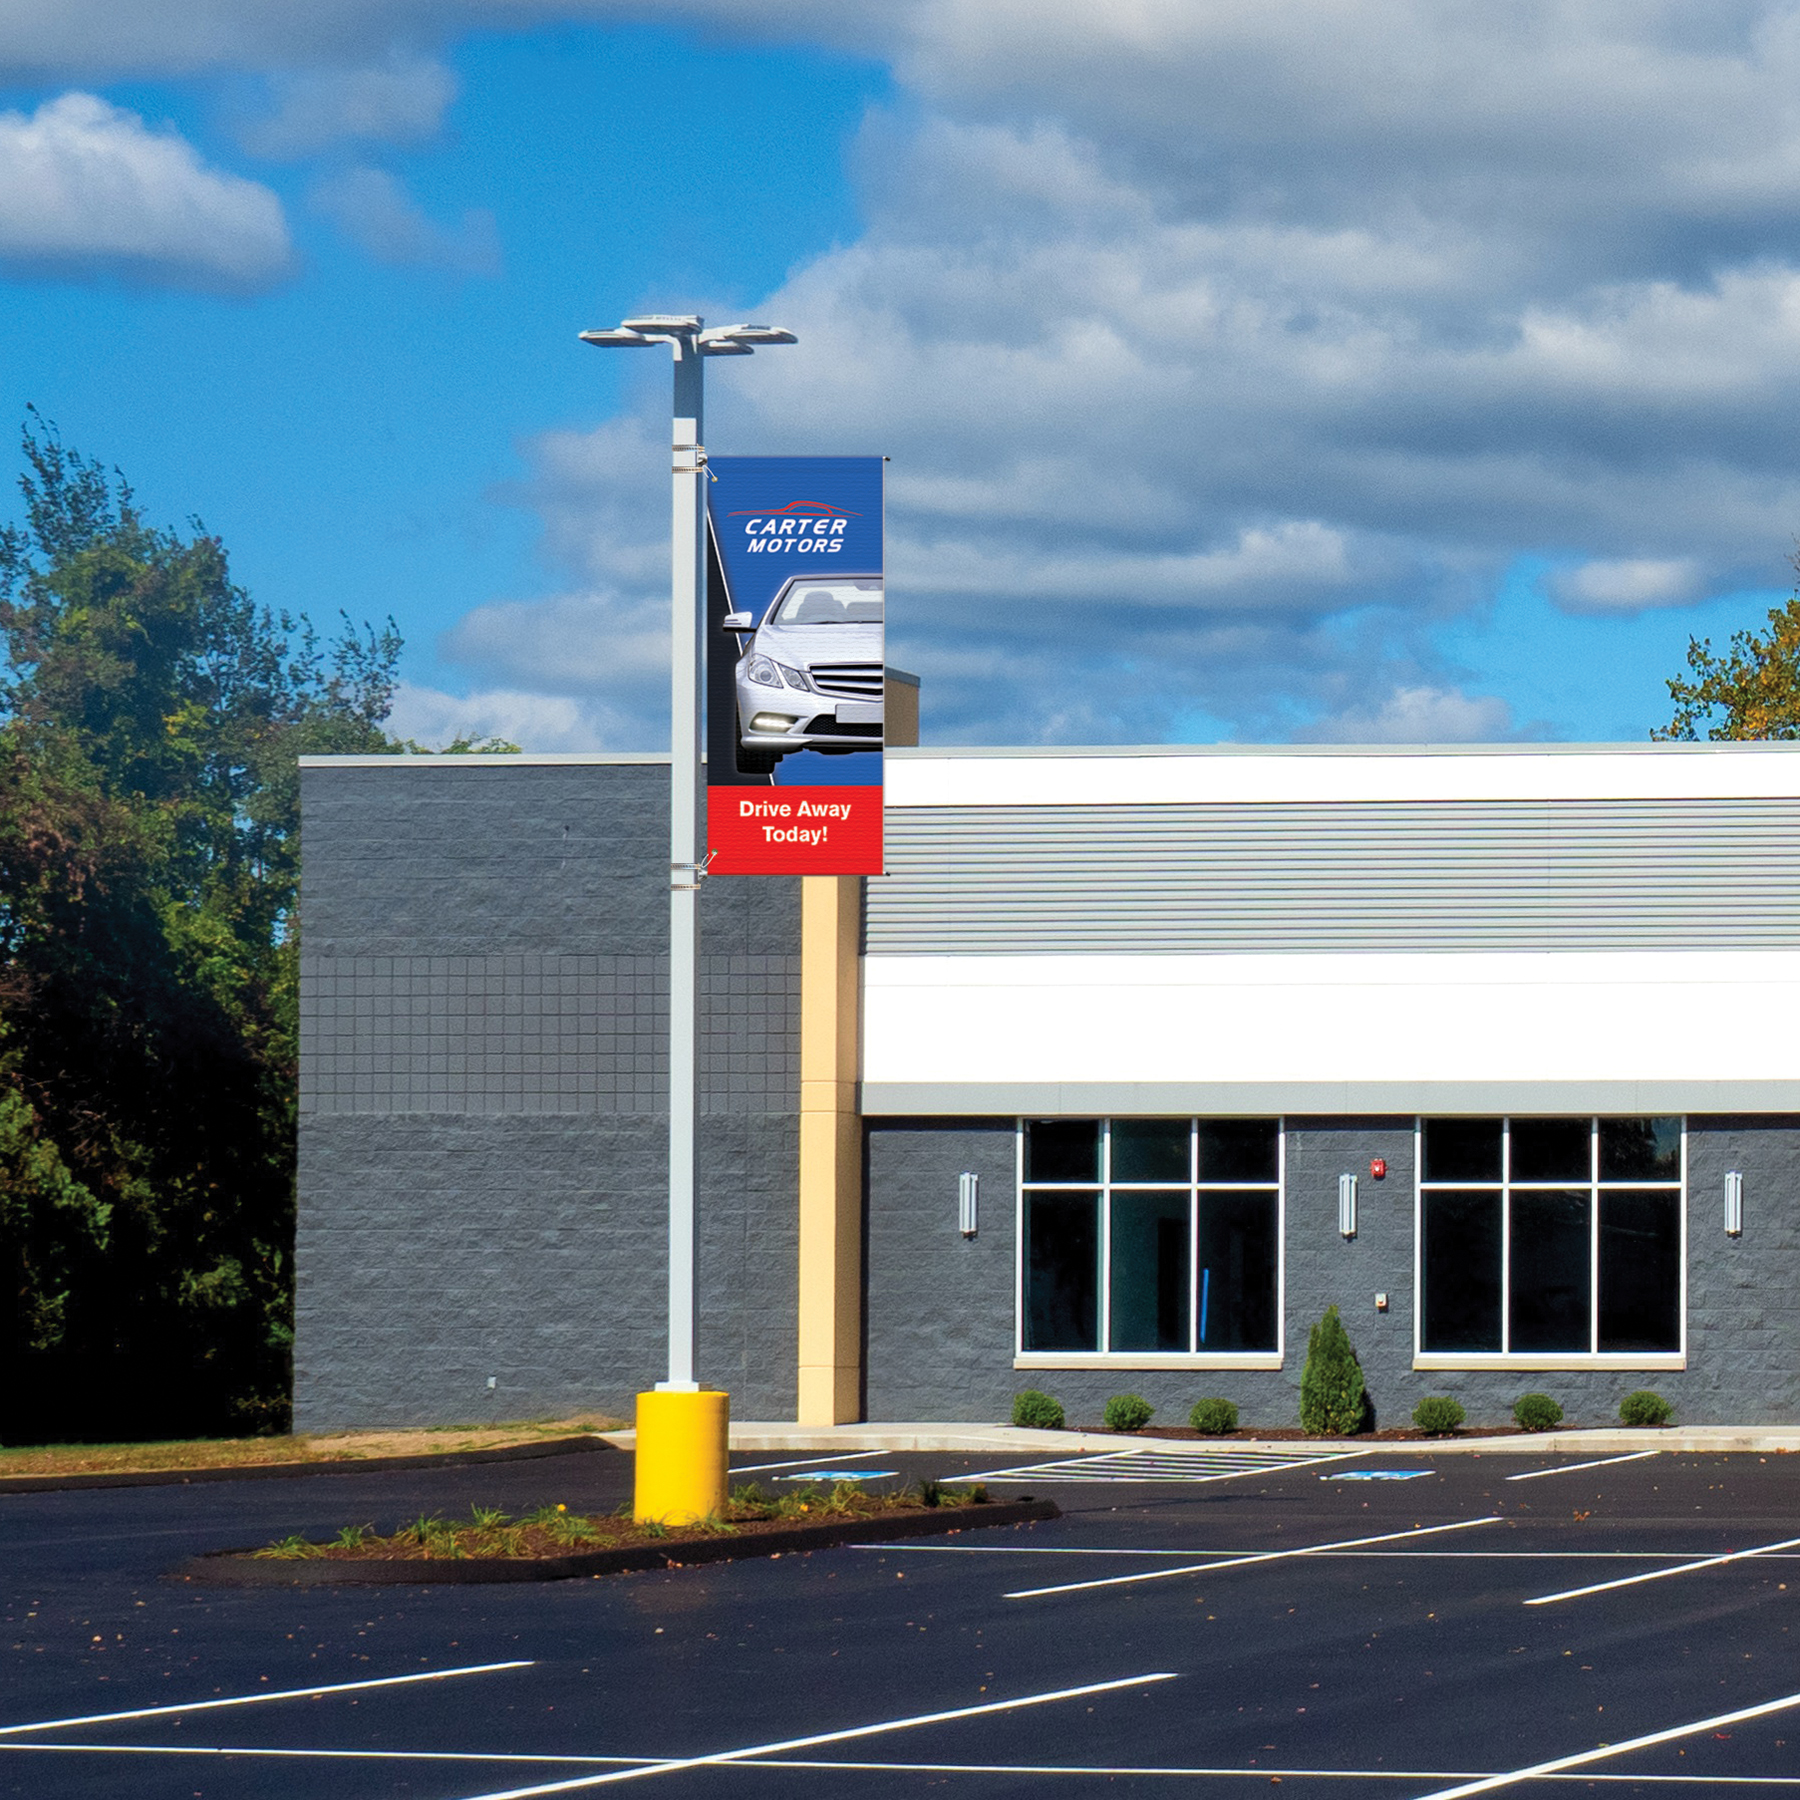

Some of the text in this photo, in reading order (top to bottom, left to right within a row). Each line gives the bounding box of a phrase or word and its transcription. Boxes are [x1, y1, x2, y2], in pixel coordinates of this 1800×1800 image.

[745, 518, 847, 535] CARTER
[747, 538, 844, 553] MOTORS
[739, 800, 851, 820] Drive Away
[762, 825, 828, 845] Today!
